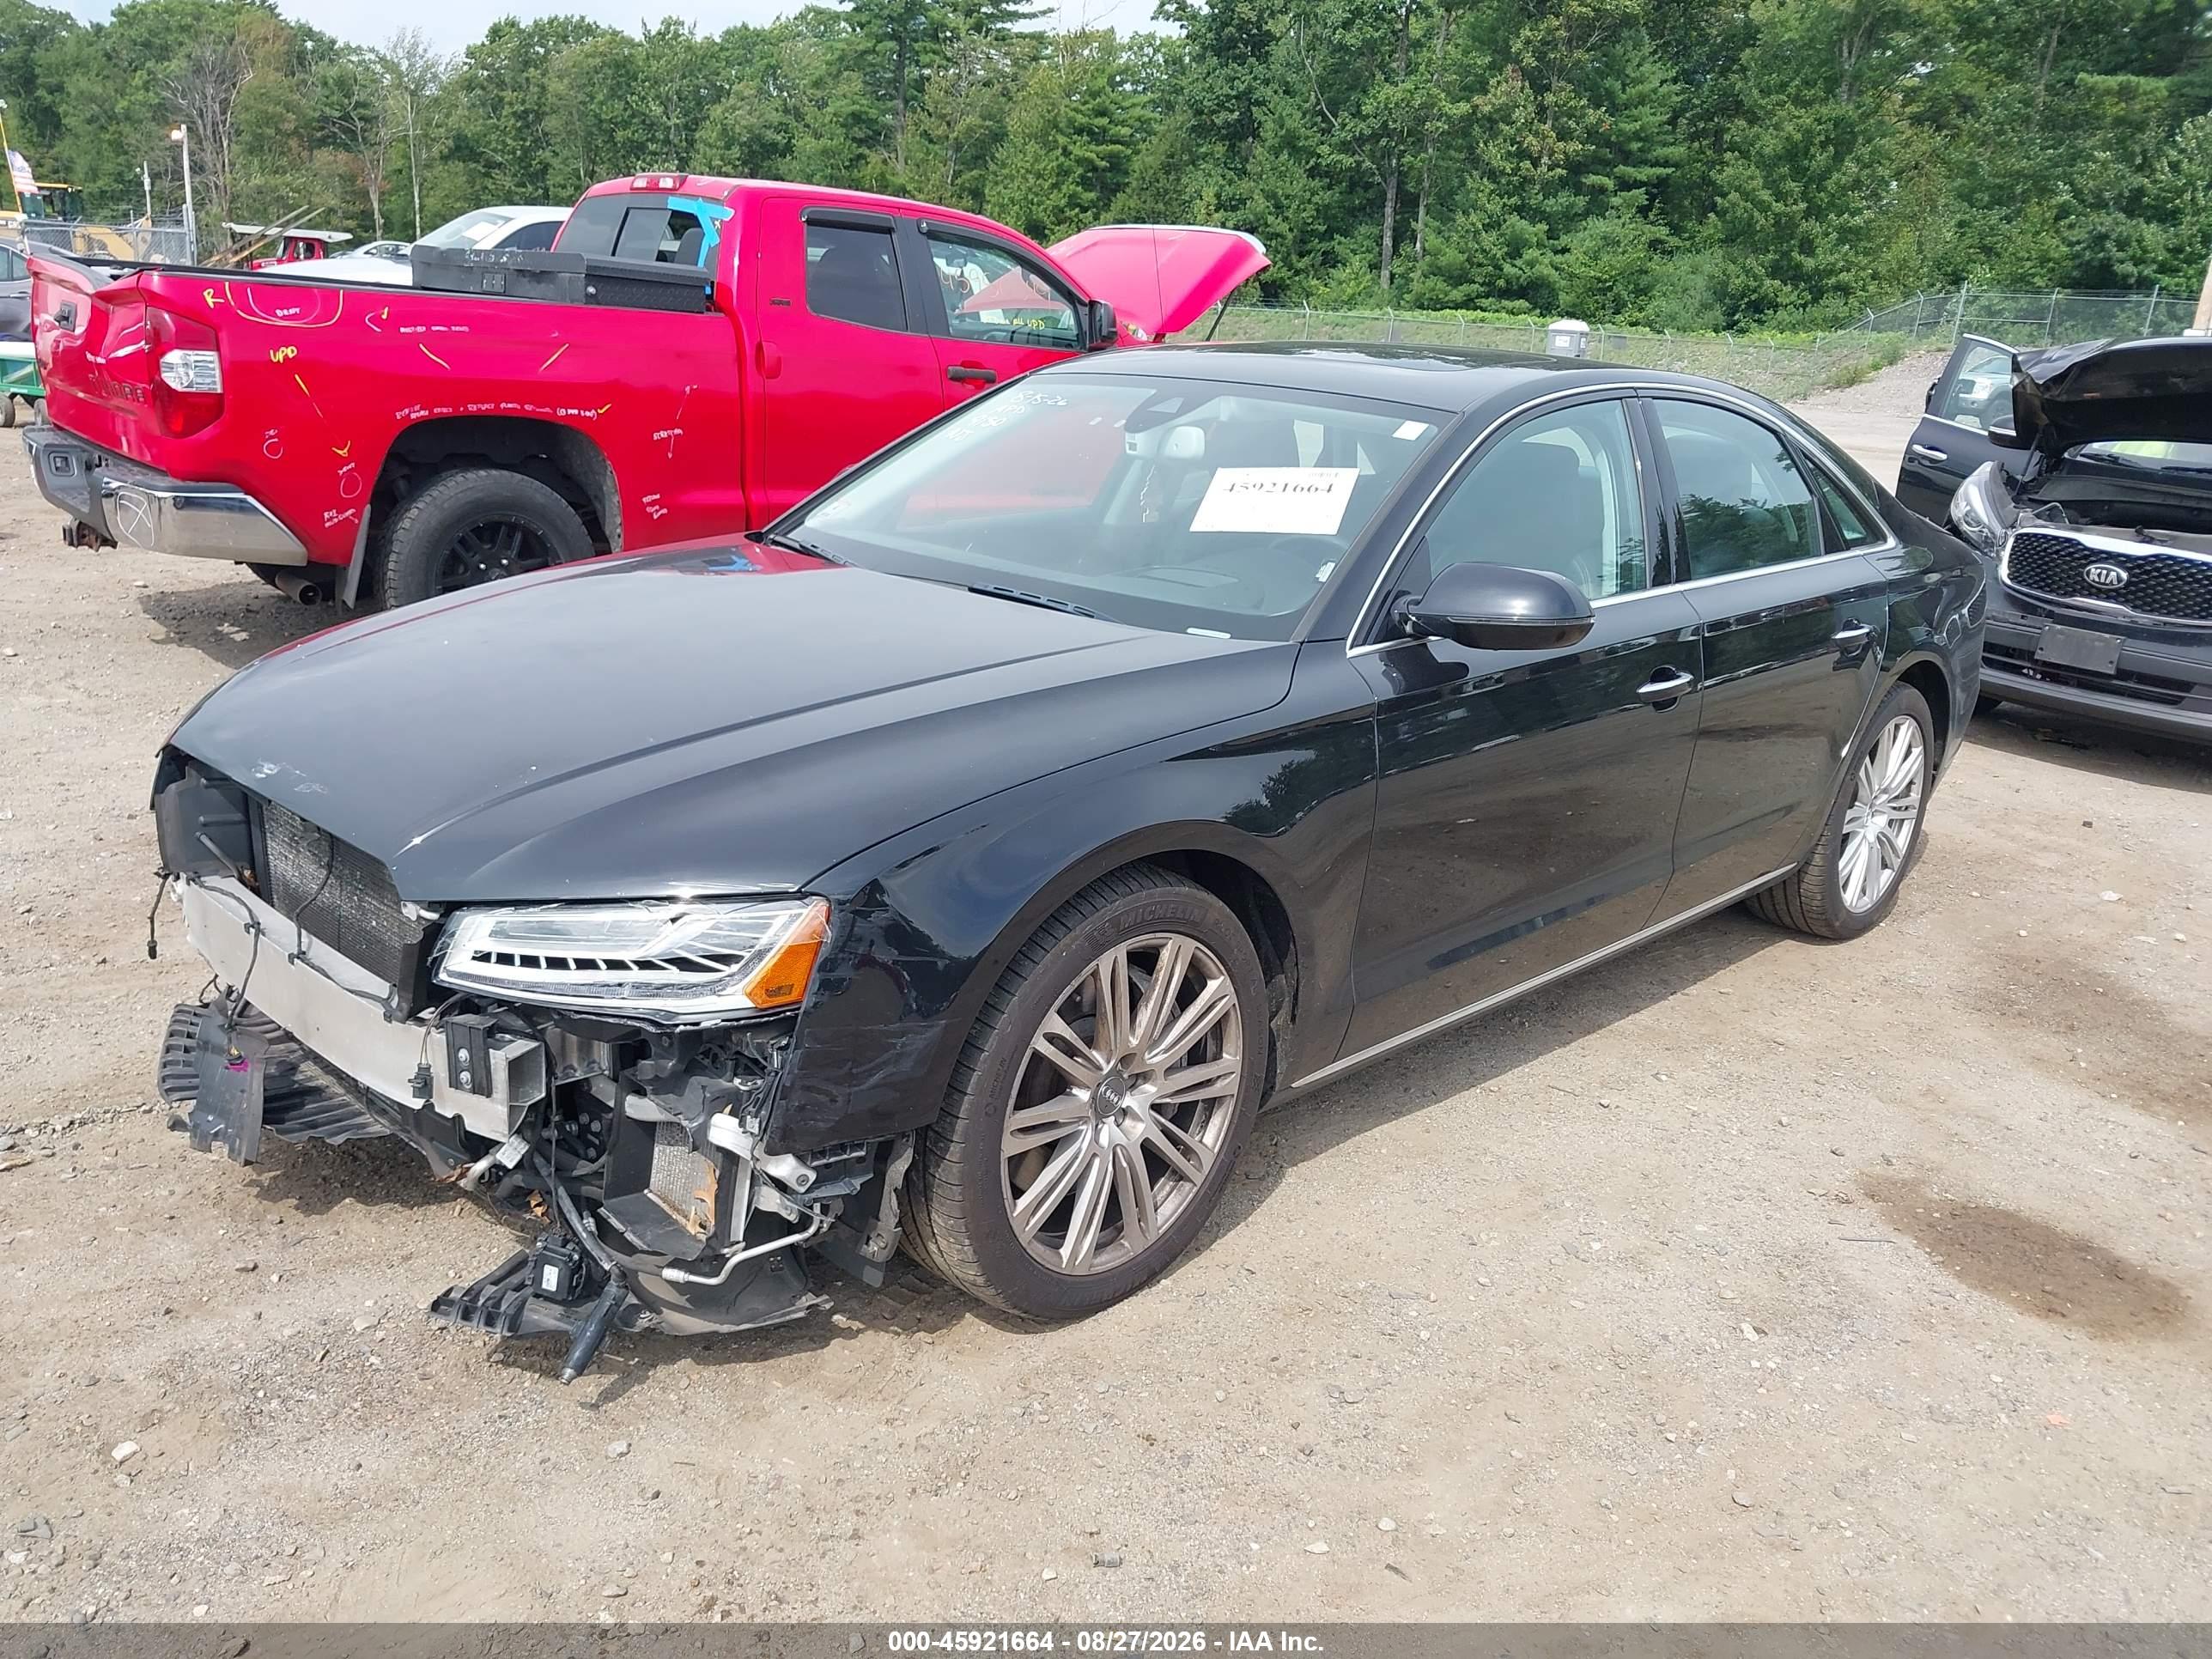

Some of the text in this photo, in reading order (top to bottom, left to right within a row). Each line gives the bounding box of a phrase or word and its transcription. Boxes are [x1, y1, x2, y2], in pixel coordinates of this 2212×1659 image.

[203, 289, 225, 308] R
[1027, 319, 1045, 330] UPD
[270, 346, 297, 363] UPD
[1223, 482, 1334, 494] 45921664
[2089, 568, 2118, 585] KIA
[1119, 904, 1205, 930] MICHELIN
